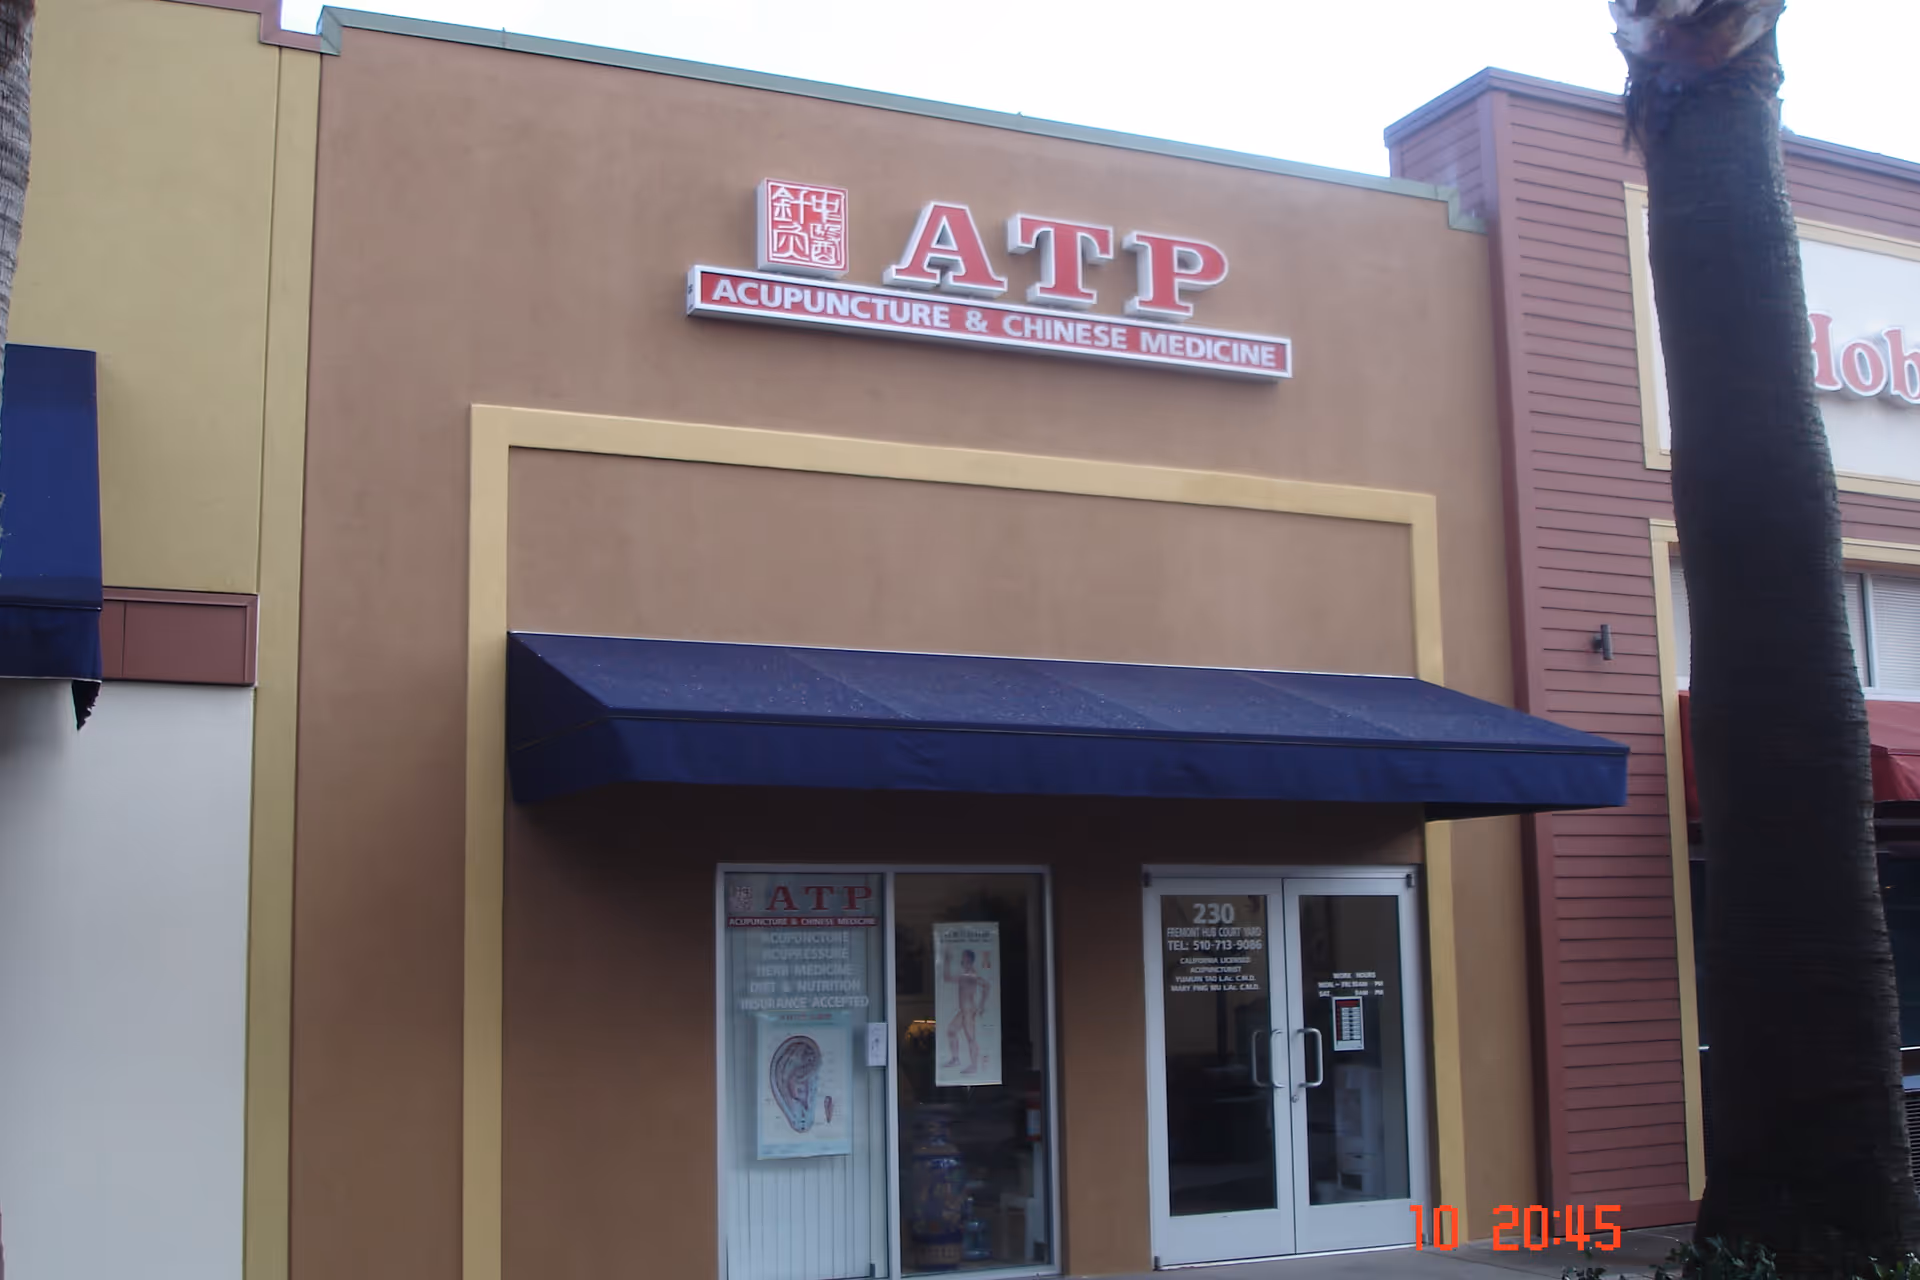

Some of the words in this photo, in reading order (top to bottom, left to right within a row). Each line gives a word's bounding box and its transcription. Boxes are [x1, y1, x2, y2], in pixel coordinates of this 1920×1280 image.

[892, 202, 1228, 316] ATP
[712, 279, 949, 328] ACUPUNCTURE
[965, 310, 988, 333] &
[1002, 315, 1127, 349] CHINESE
[1139, 331, 1277, 367] MEDICINE
[765, 885, 873, 911] ATP
[1193, 903, 1235, 924] 230
[729, 918, 787, 926] ACUPUNCTURE
[801, 918, 834, 926] CHINESE
[761, 931, 850, 944] ACUPUNCTURE
[1167, 927, 1200, 938] FREMONT
[1202, 927, 1217, 938] HUB
[1218, 927, 1241, 937] COURT
[1242, 926, 1263, 937] YARD
[1167, 940, 1189, 951] TEL:
[762, 947, 850, 960] ACUPRESSURE
[794, 963, 855, 976] MEDICINE
[750, 981, 777, 993] DIET
[797, 979, 861, 992] NUTRITION
[741, 997, 808, 1010] INSURANCE
[811, 995, 869, 1008] ACCEPTED
